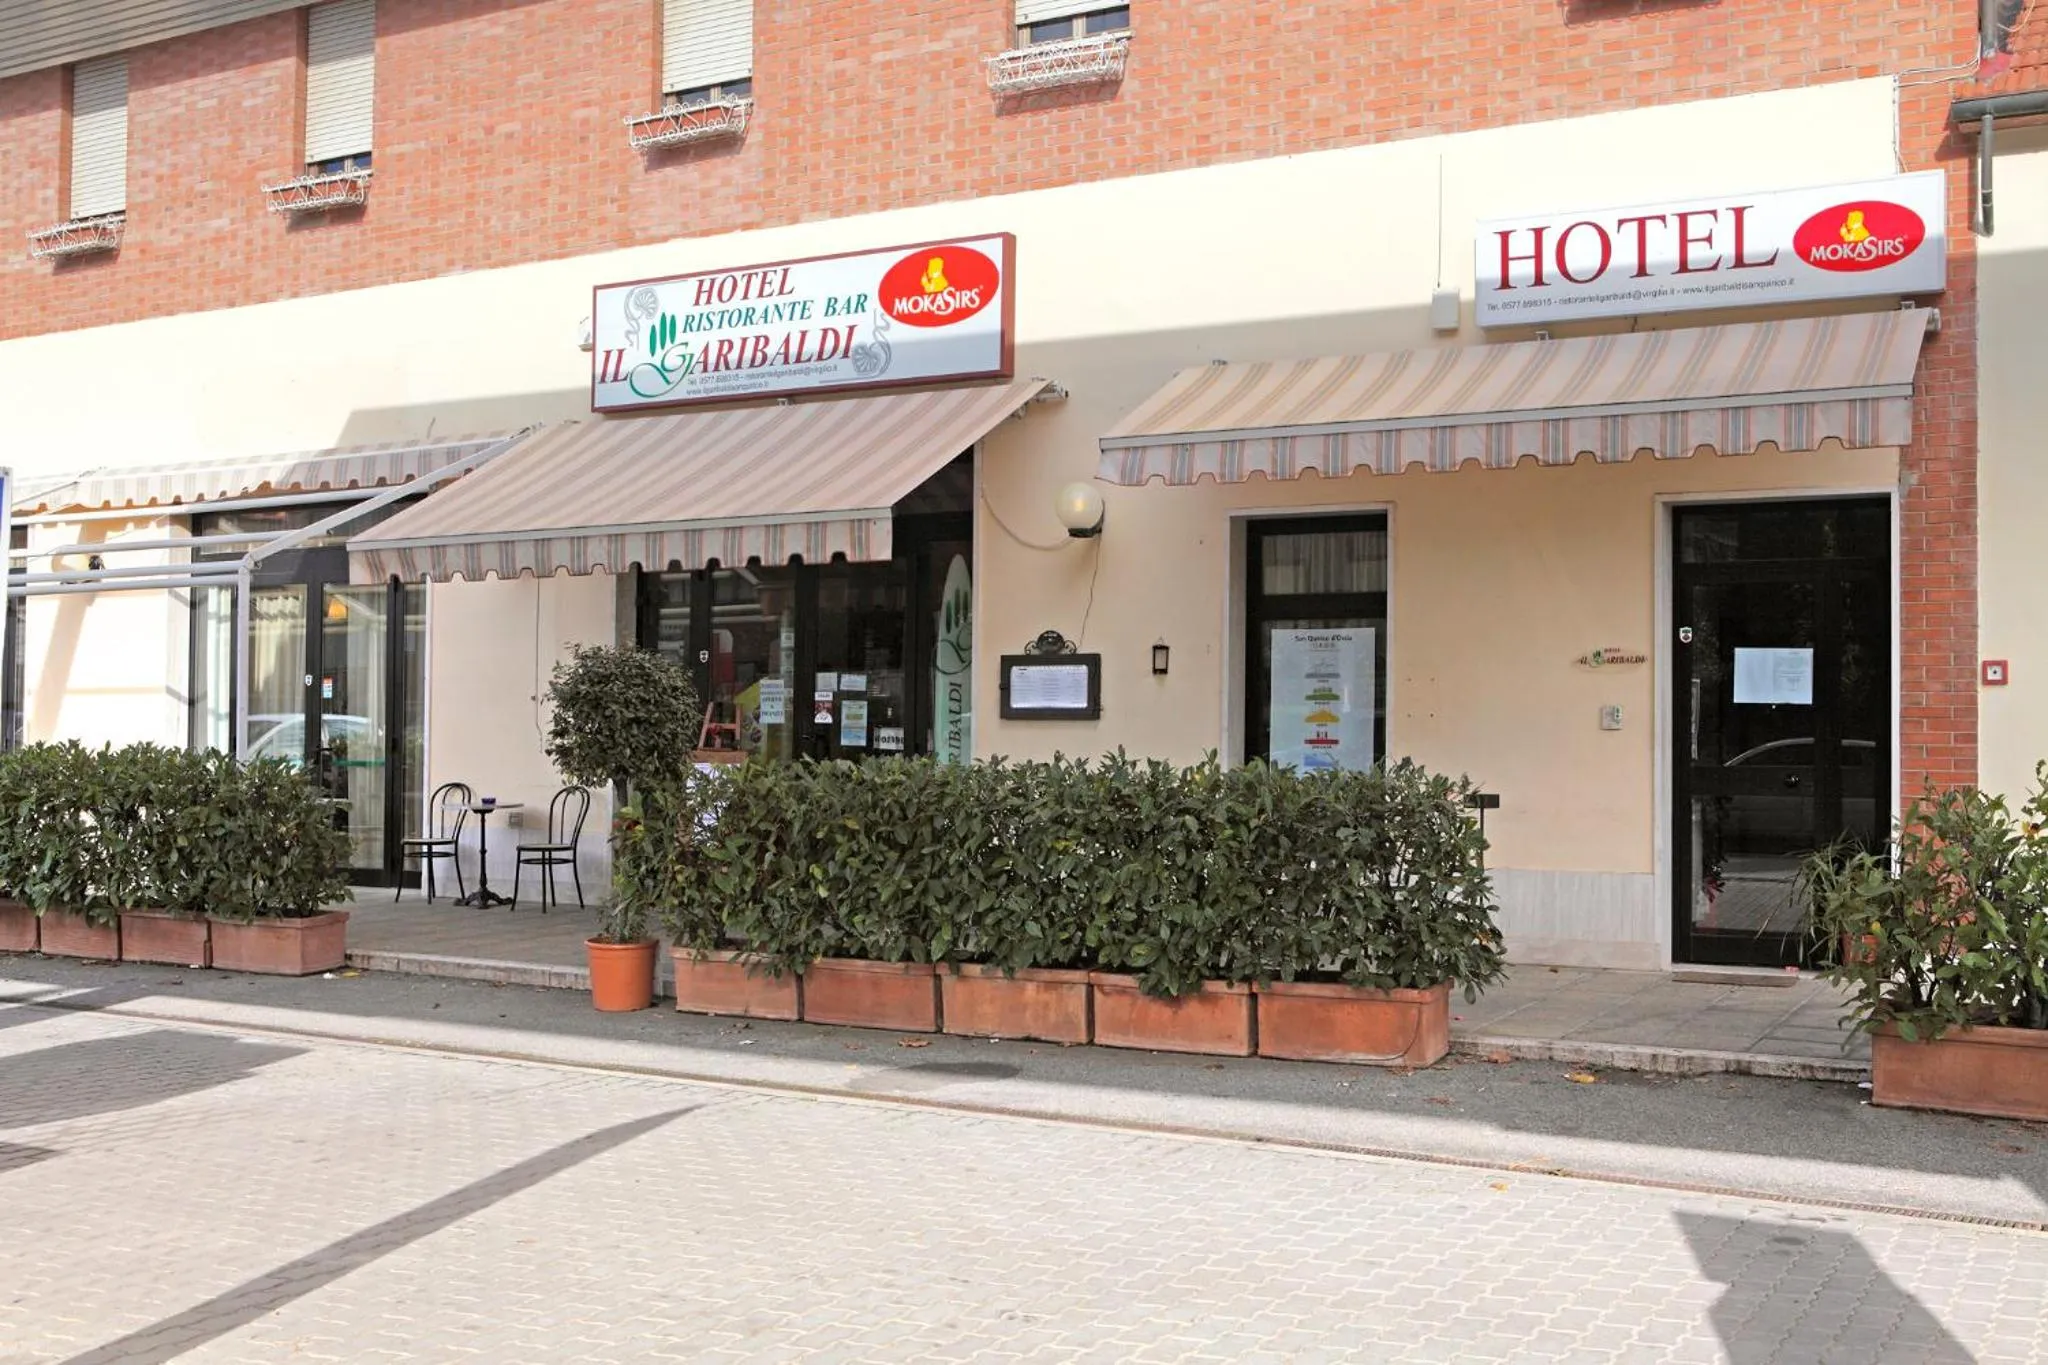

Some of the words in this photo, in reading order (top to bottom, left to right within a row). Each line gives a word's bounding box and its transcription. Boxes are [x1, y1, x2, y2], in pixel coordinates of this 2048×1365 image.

[1492, 205, 1779, 290] HOTEL
[682, 299, 814, 333] RISTORANTE
[824, 292, 868, 318] BAR
[693, 267, 795, 306] HOTEL
[599, 348, 630, 384] IL
[630, 324, 859, 398] GARIBALDI
